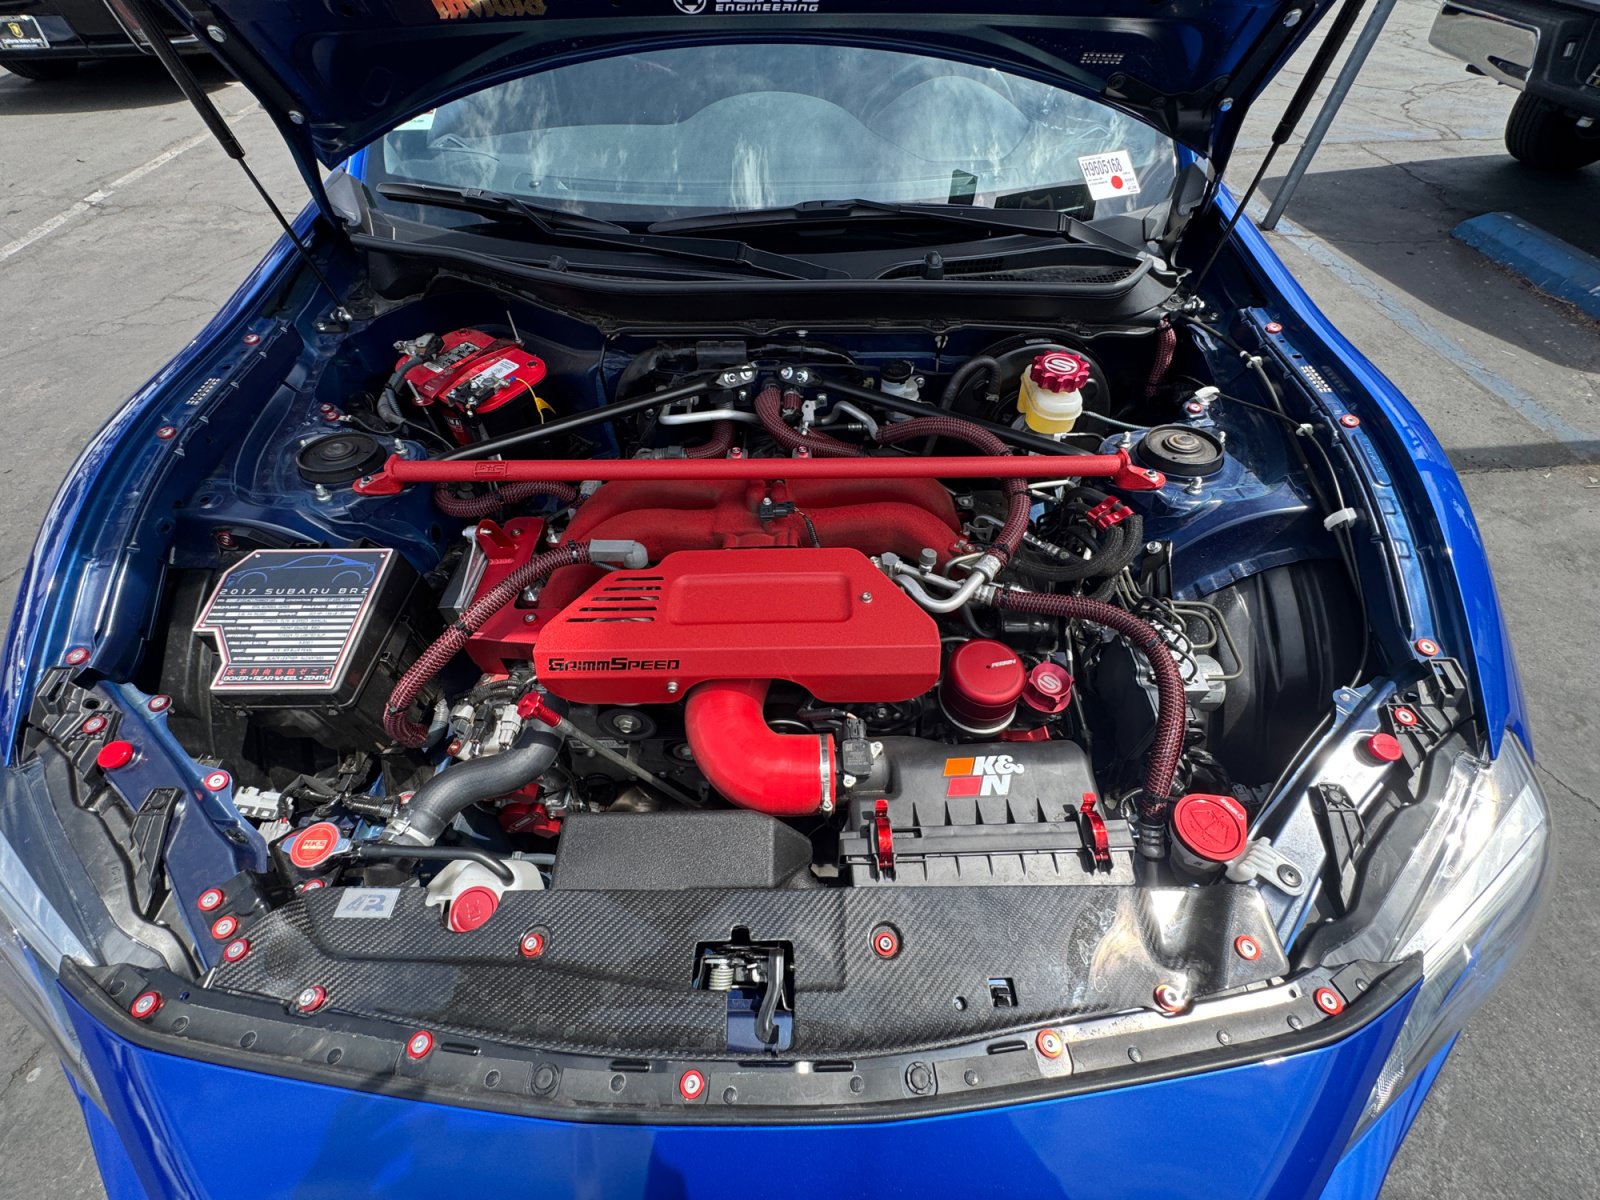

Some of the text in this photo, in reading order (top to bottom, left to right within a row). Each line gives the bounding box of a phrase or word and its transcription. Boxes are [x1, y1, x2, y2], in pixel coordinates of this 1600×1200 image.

[715, 3, 819, 12] ENGINEERING
[1081, 157, 1123, 178] H9605168
[264, 587, 330, 595] SUBARU
